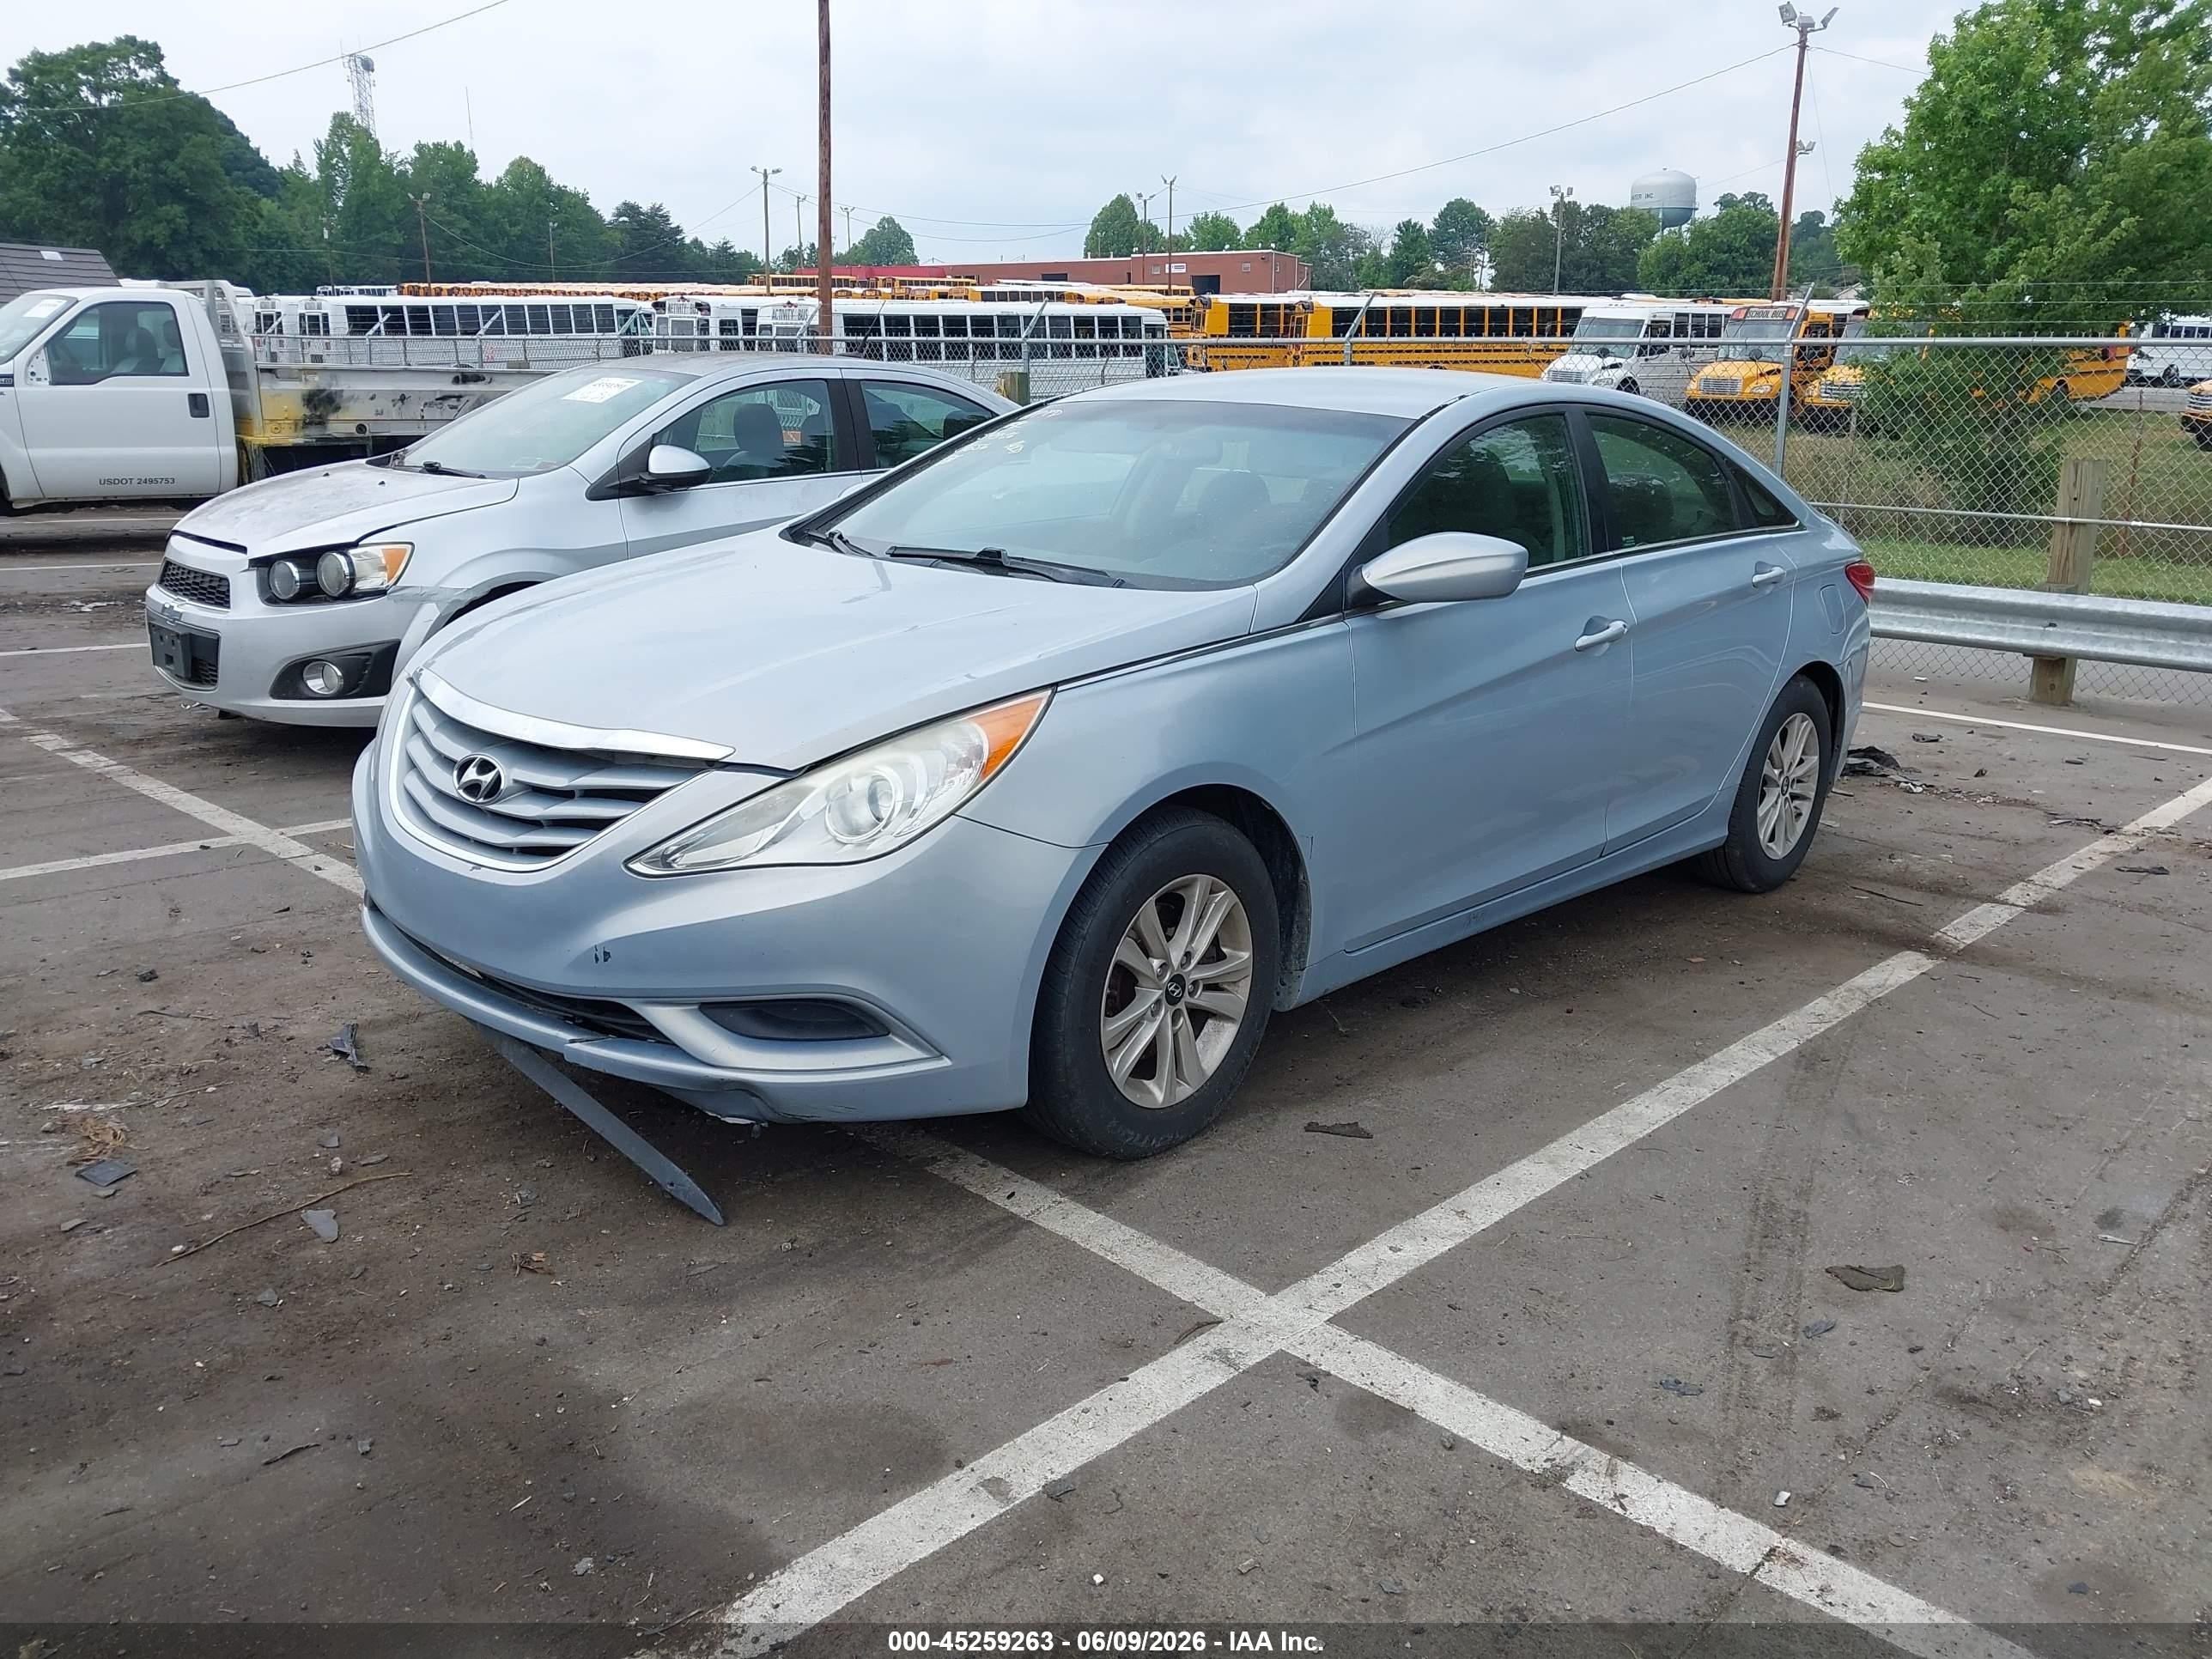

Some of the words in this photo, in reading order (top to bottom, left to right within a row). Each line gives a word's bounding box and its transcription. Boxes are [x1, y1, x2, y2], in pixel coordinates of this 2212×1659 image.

[772, 308, 794, 320] ACTIVITY
[797, 308, 809, 320] BUS
[1747, 310, 1771, 319] SCHOOL
[1771, 310, 1786, 319] BUS
